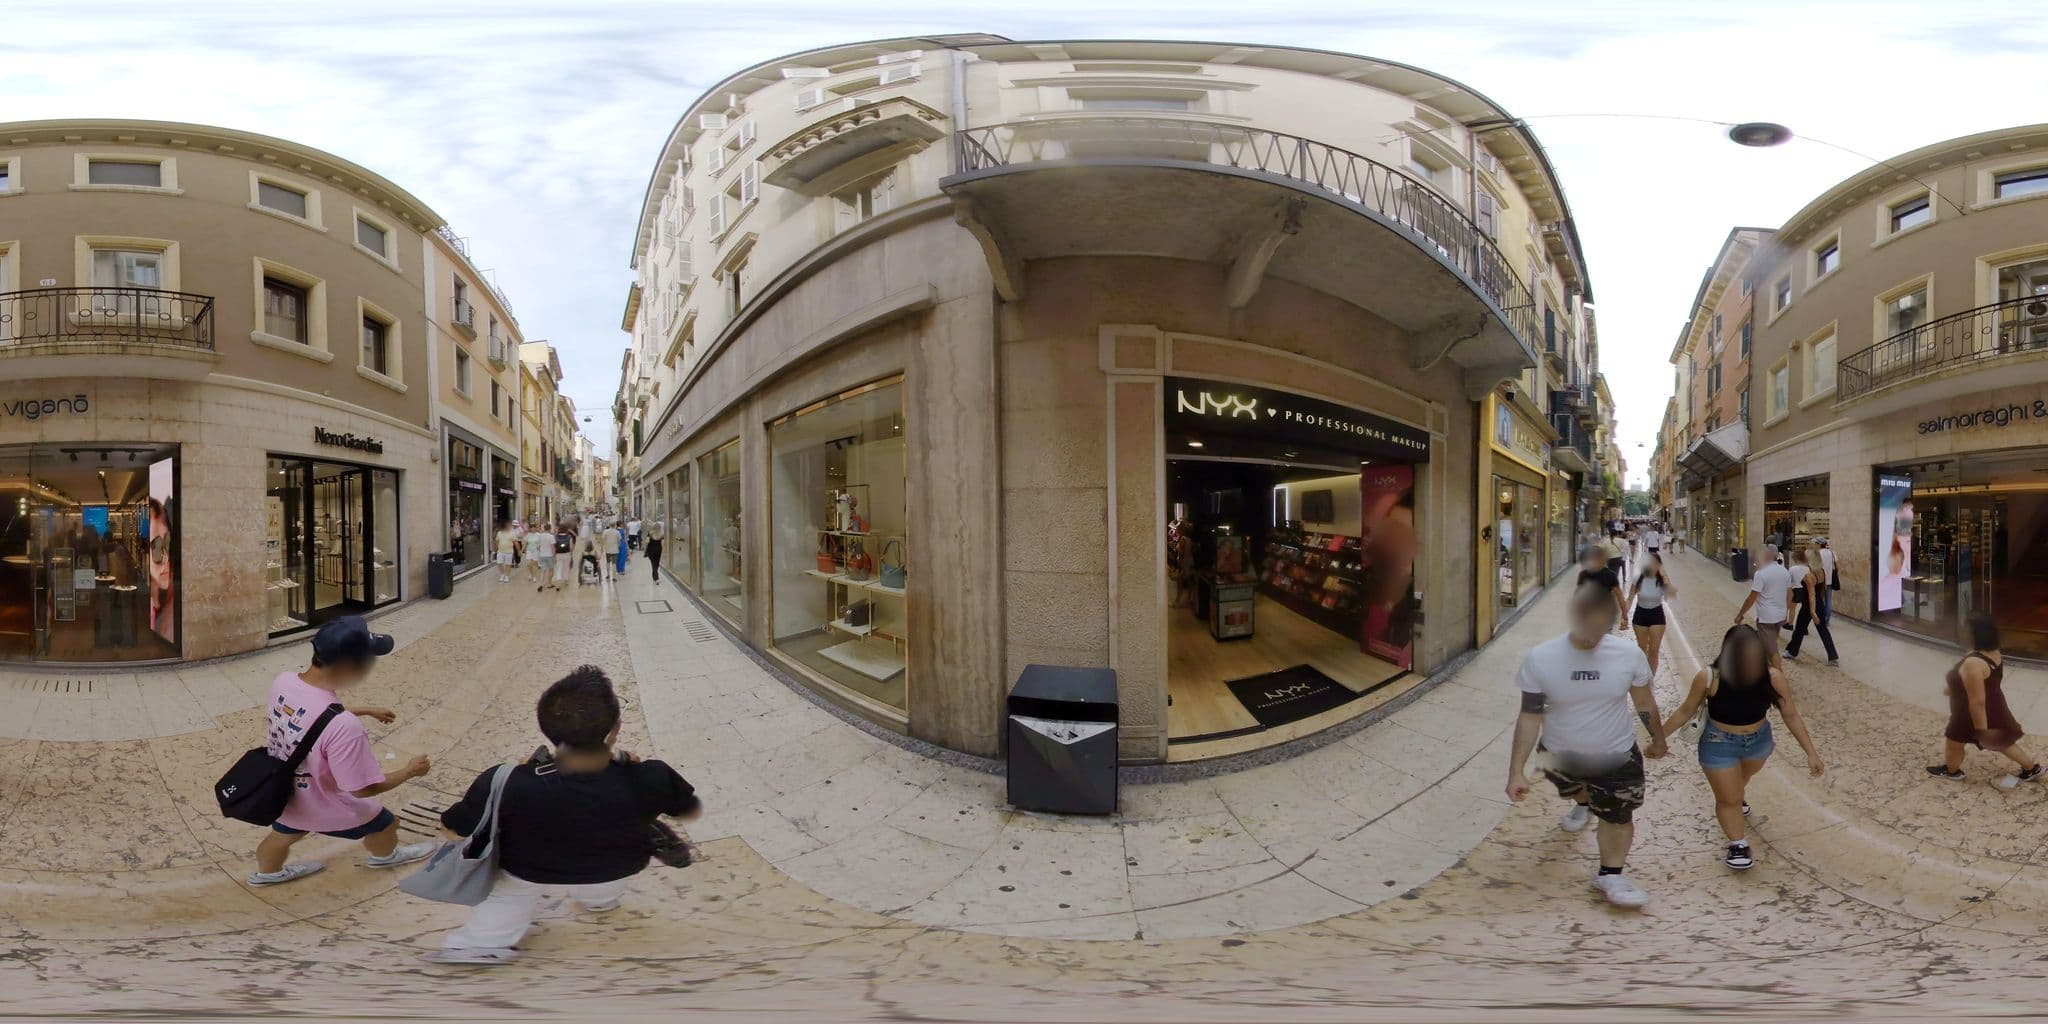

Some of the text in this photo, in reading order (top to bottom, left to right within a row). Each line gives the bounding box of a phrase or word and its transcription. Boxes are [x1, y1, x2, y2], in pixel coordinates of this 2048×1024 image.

[1178, 390, 1426, 450] NYX PROFESSIONAL MAKEUP
[1918, 400, 2048, 434] salmoiraghi &
[314, 426, 383, 454] NeroGiardini
[1264, 683, 1311, 700] NYX
